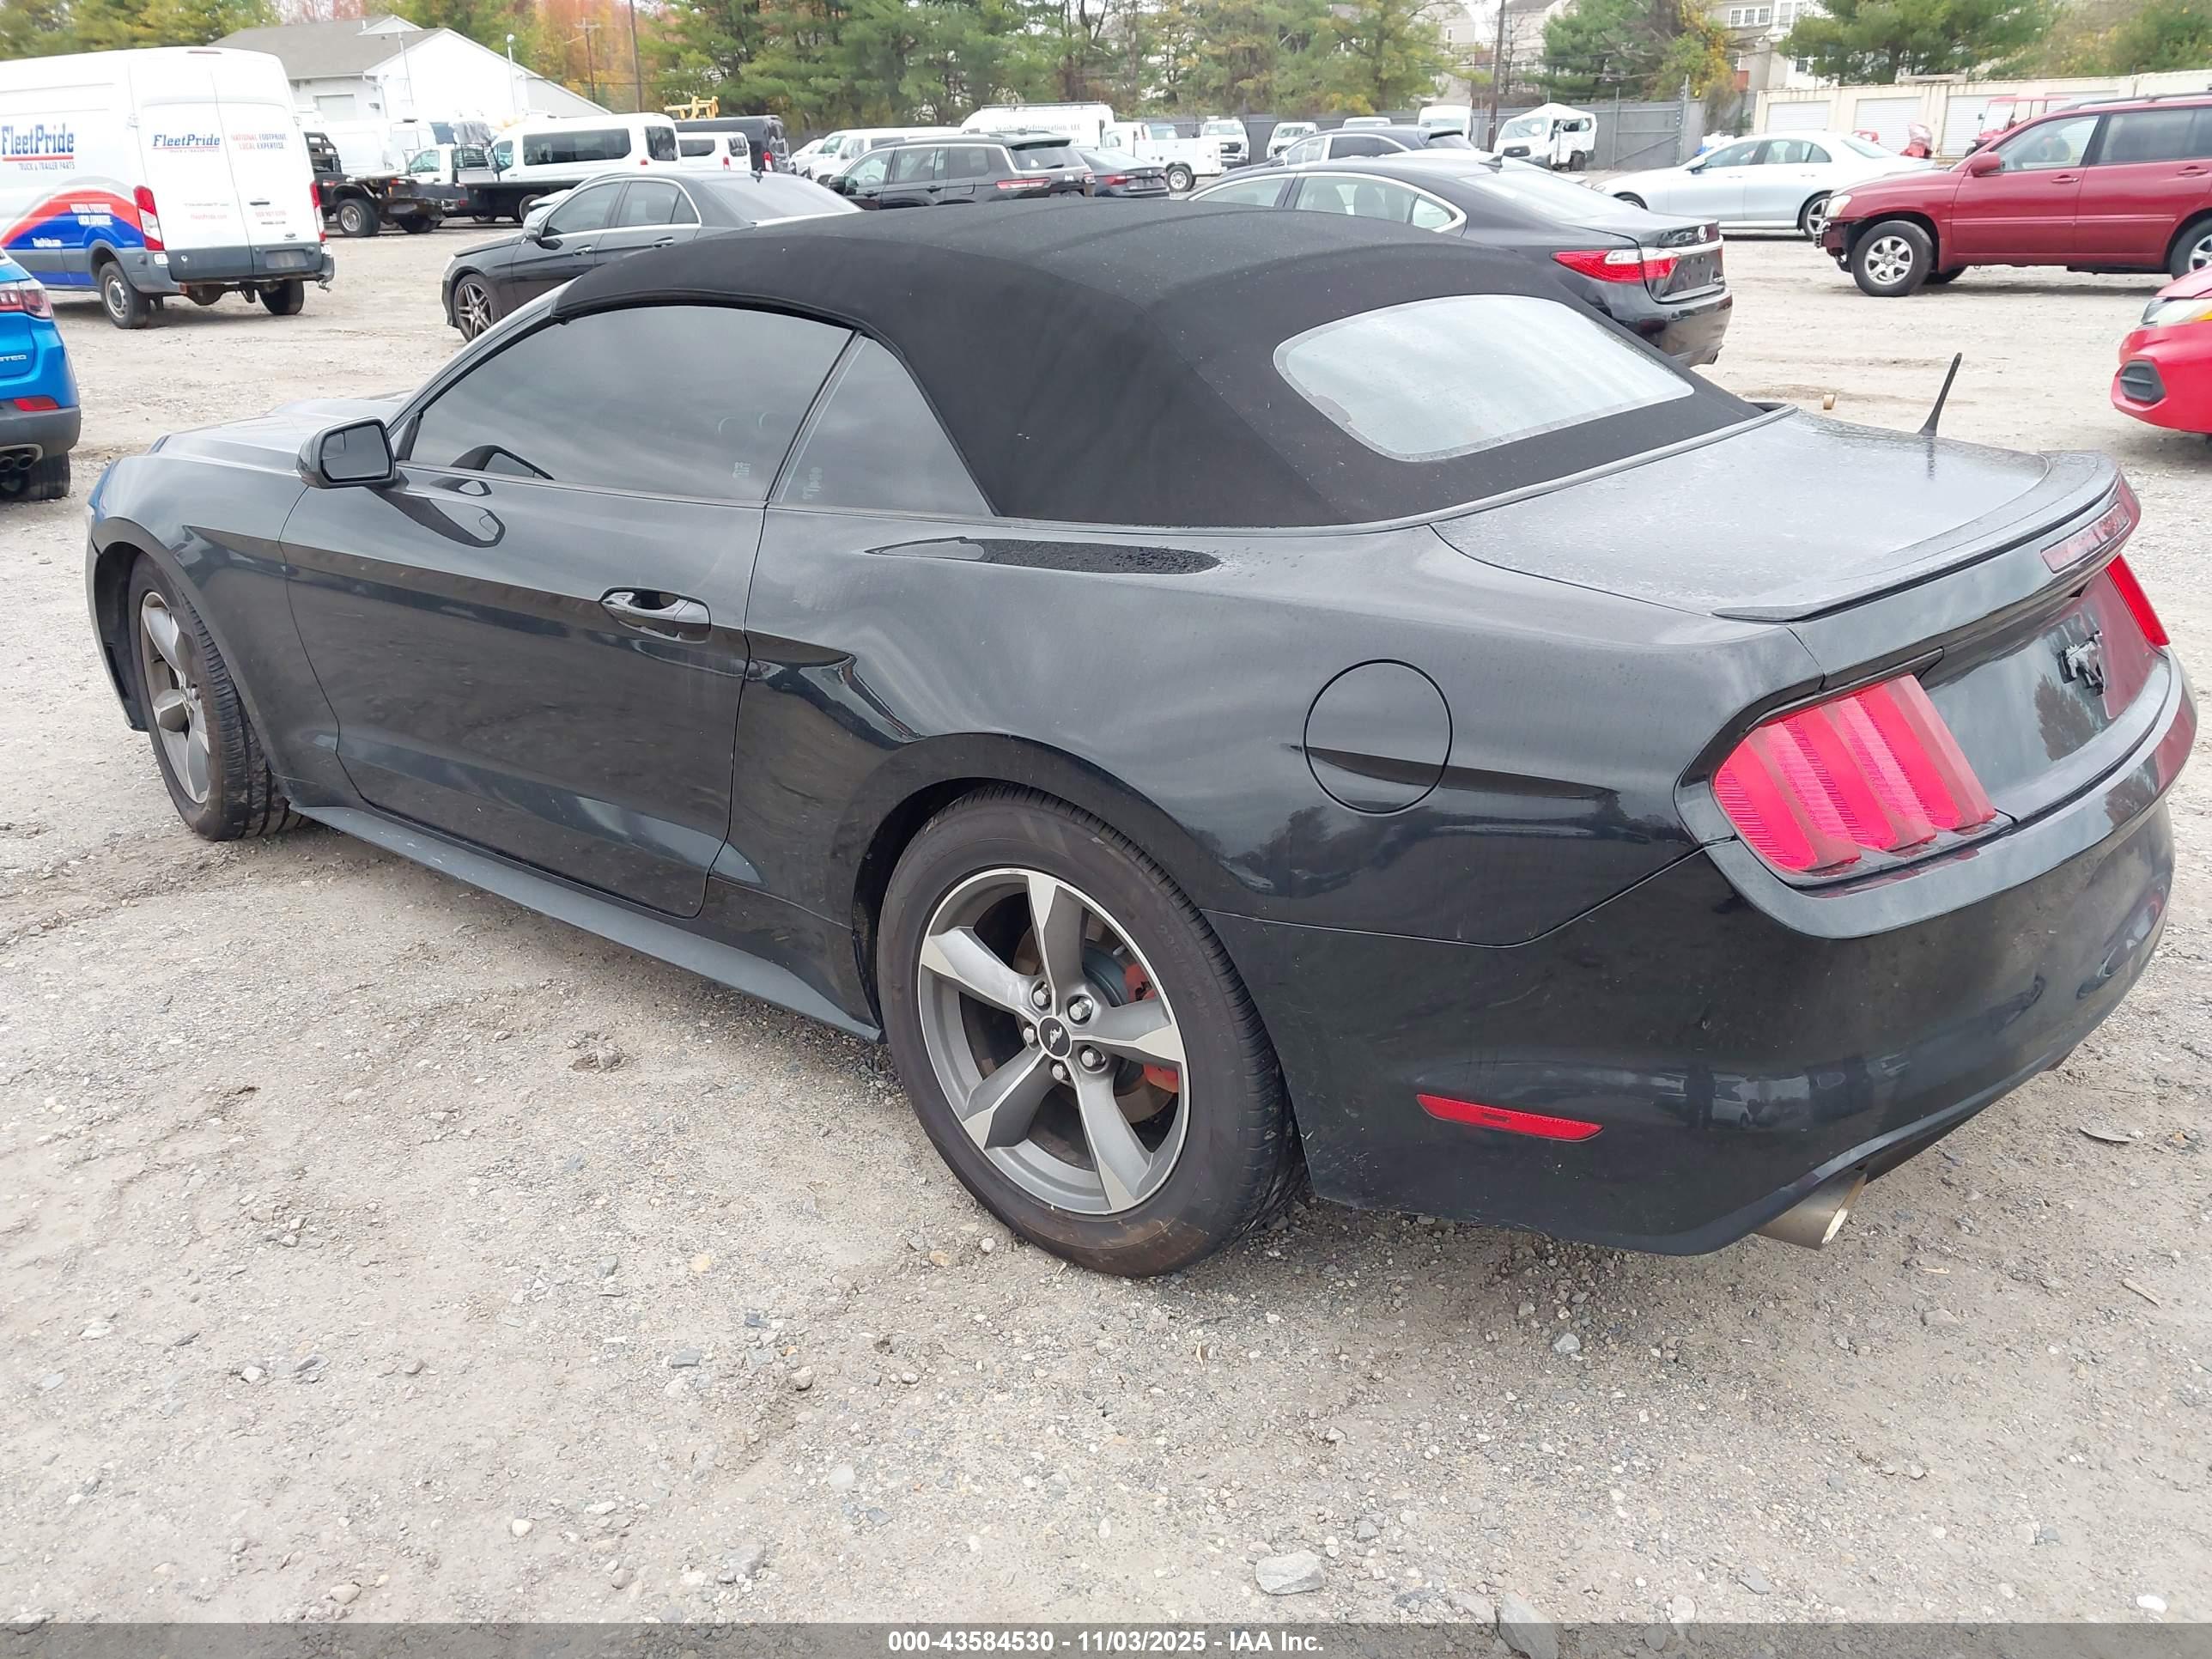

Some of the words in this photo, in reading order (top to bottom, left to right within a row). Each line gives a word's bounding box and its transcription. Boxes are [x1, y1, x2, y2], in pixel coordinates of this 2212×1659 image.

[2, 123, 74, 155] FleetPride
[153, 133, 221, 147] FleetPride
[58, 161, 75, 169] PARTS
